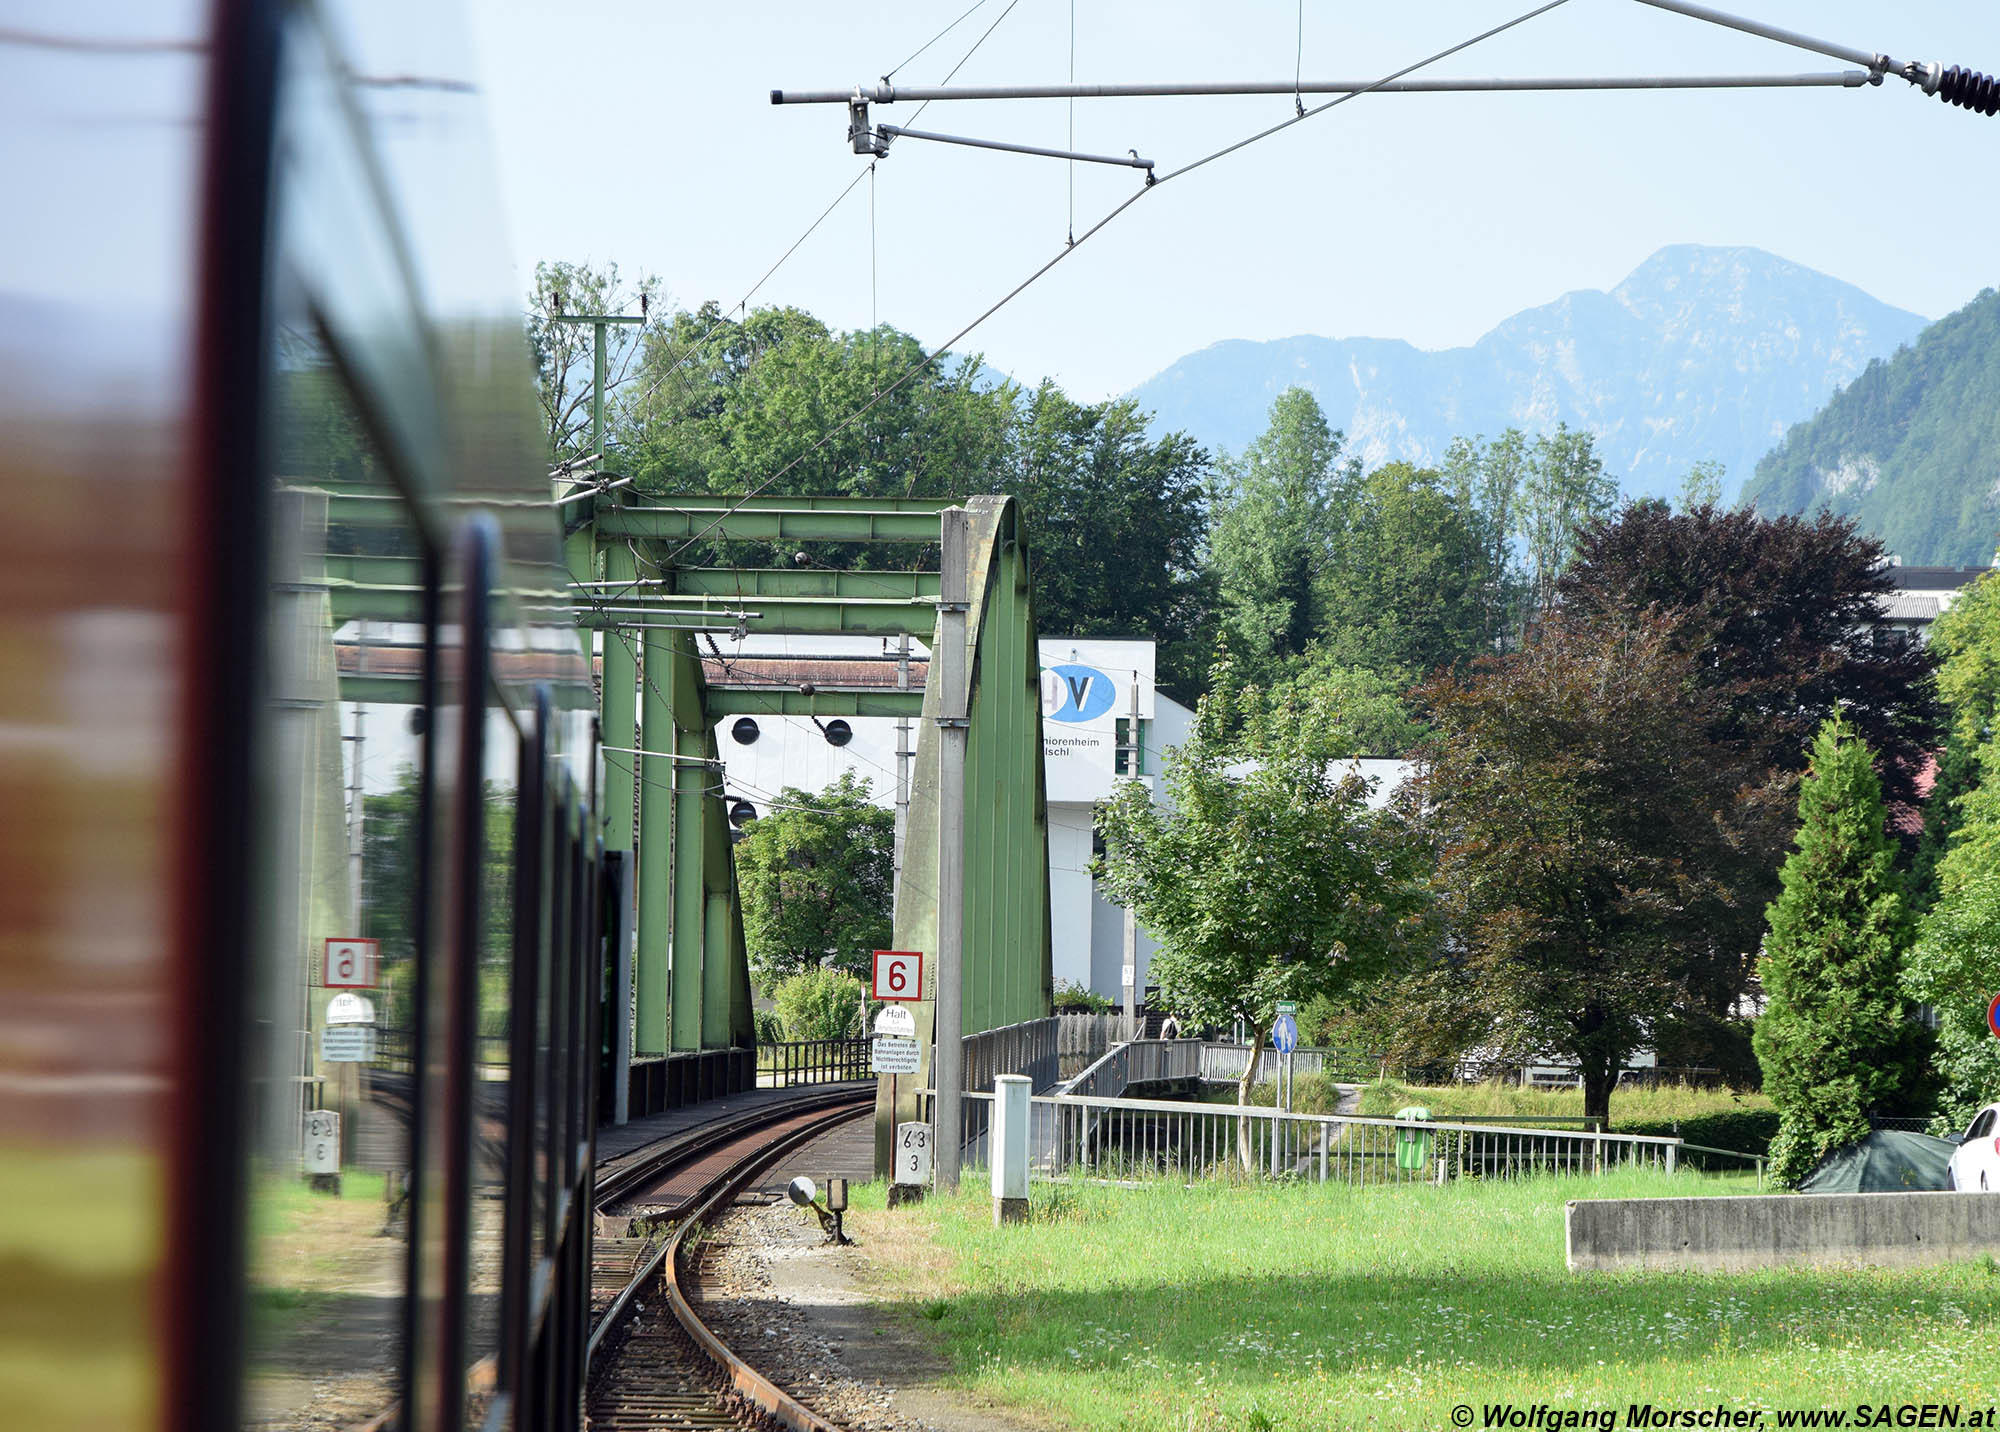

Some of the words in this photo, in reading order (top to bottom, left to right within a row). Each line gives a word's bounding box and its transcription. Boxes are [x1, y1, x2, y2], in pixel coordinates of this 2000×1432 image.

[889, 961, 906, 992] 6
[886, 1009, 907, 1019] Halt
[904, 1130, 925, 1148] 63
[910, 1155, 918, 1171] 3
